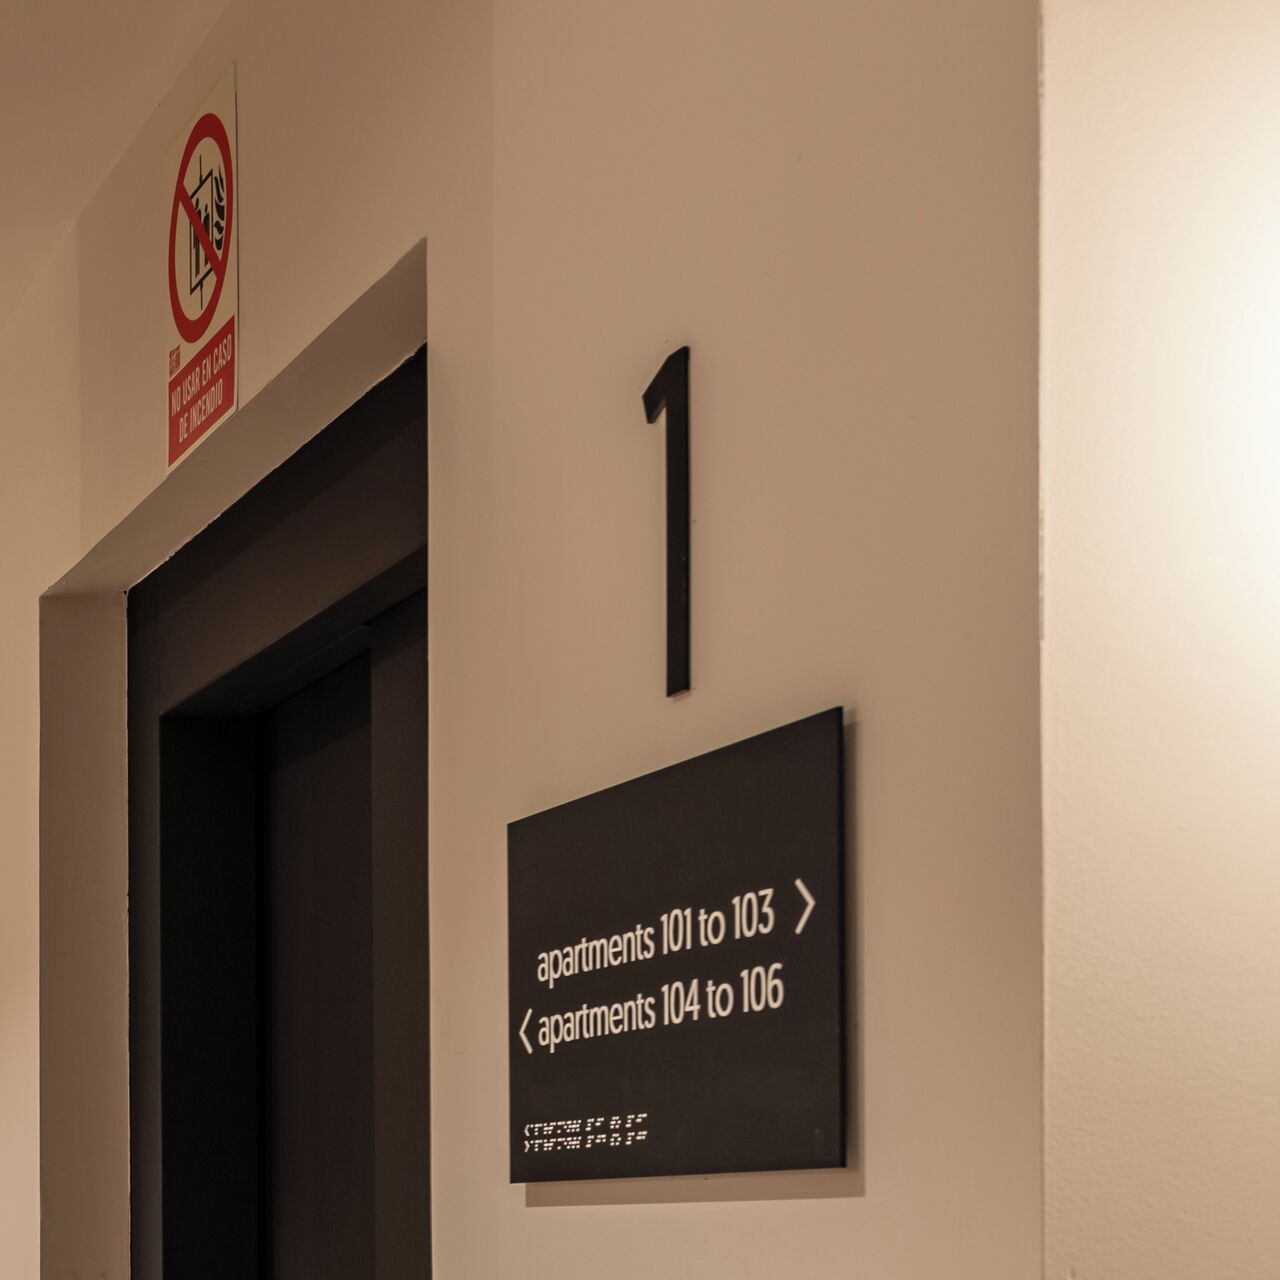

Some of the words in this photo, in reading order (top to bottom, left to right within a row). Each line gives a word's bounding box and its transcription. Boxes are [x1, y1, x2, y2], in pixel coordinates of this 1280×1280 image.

[172, 386, 181, 416] NO
[183, 366, 200, 405] USAR
[202, 354, 211, 386] EN
[213, 334, 232, 375] CASO
[179, 412, 188, 444] DE
[190, 378, 223, 433] INCENDIO
[642, 346, 690, 698] 1
[537, 924, 655, 989] apartments
[660, 907, 692, 955] 101
[698, 908, 726, 947] to
[732, 888, 775, 940] 103
[538, 994, 656, 1054] apartments
[661, 979, 701, 1026] 104
[706, 980, 734, 1019] to
[740, 962, 784, 1013] 106
